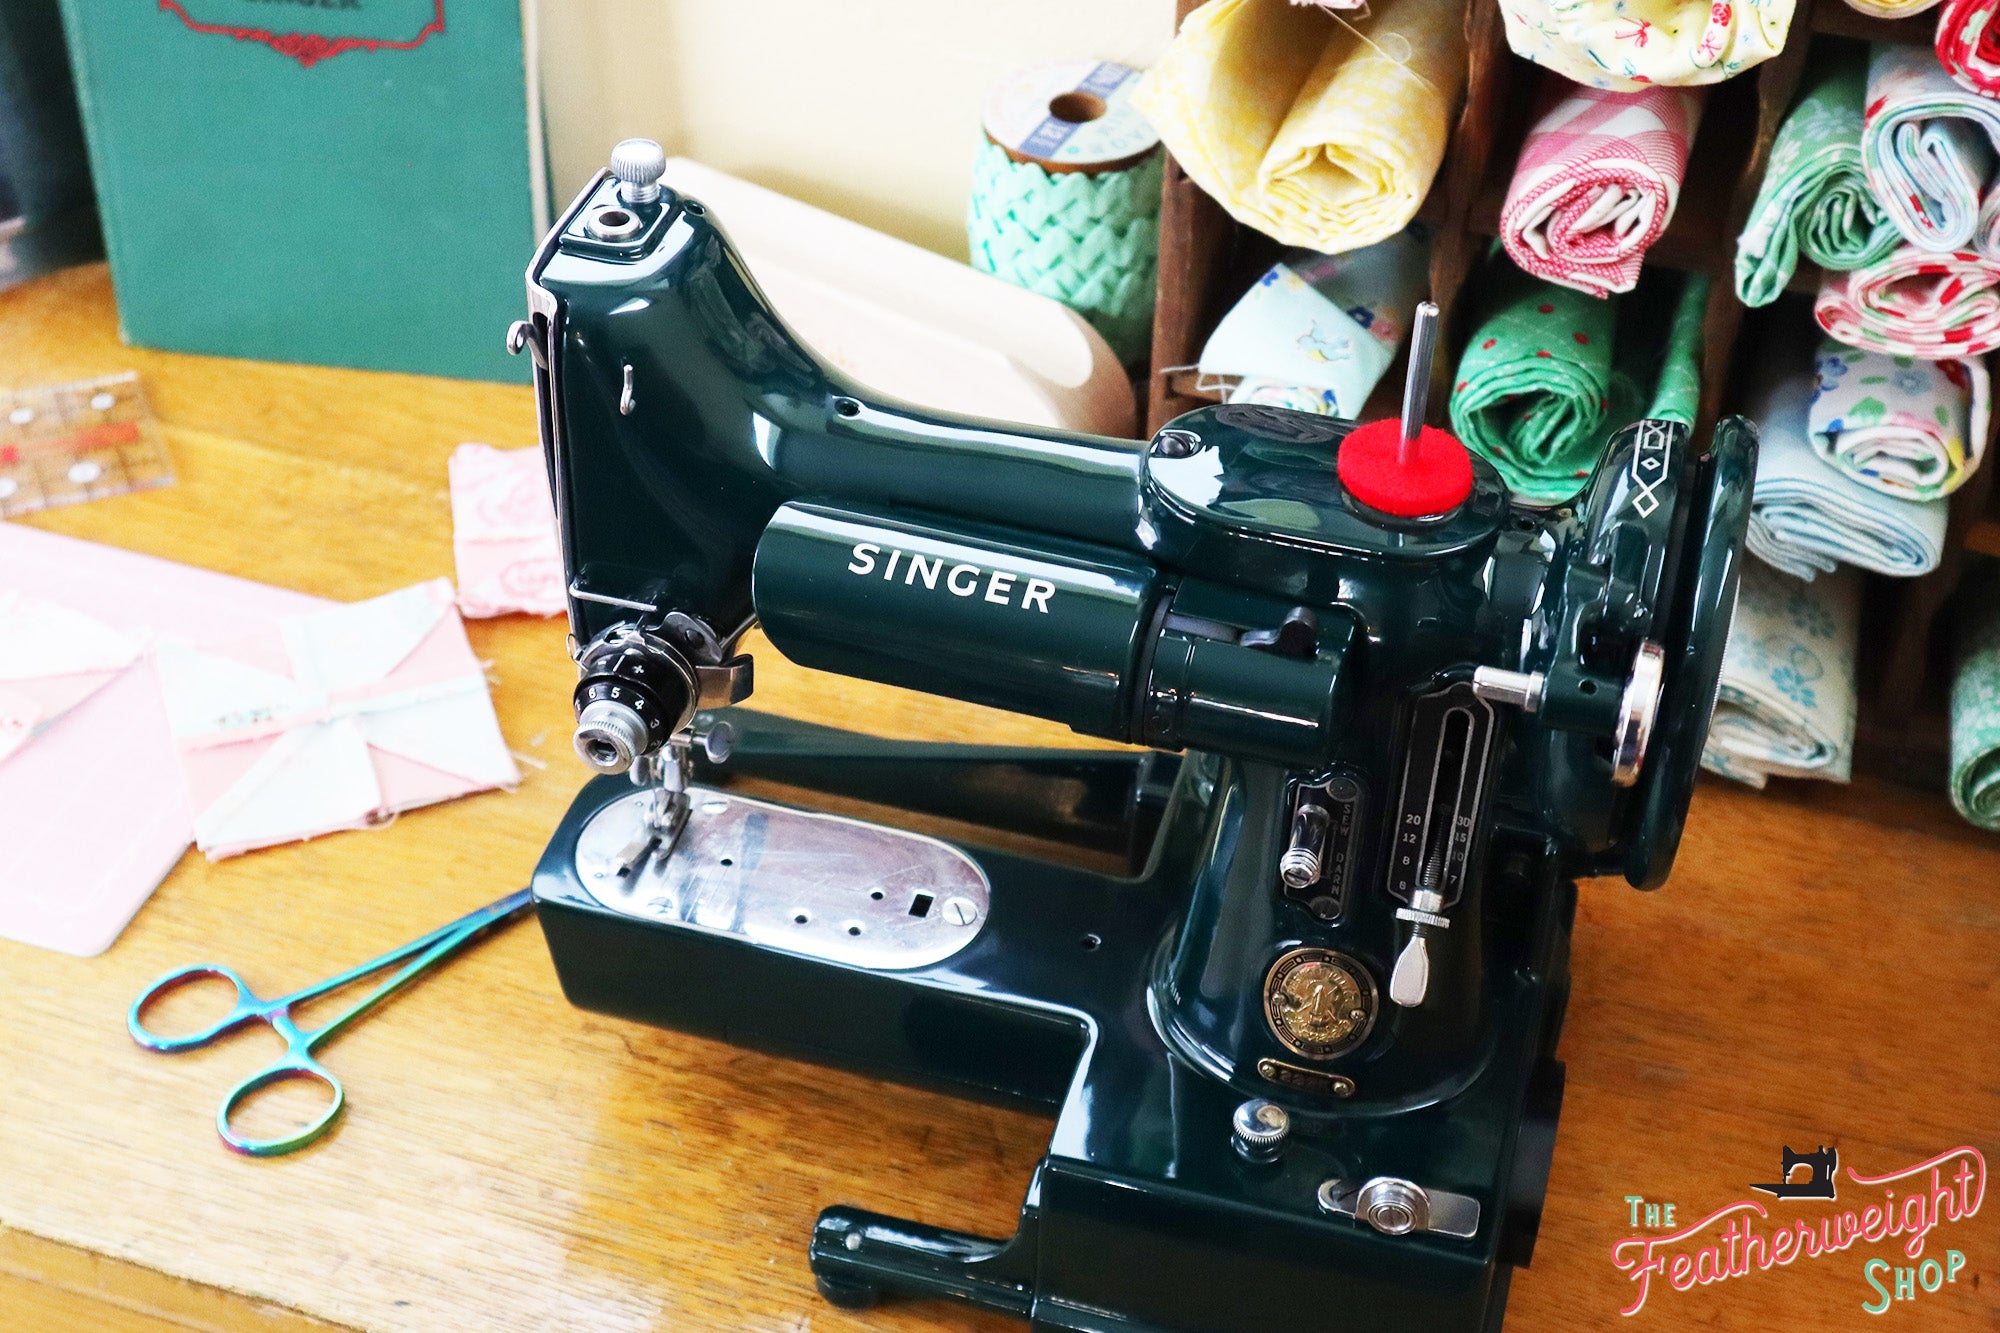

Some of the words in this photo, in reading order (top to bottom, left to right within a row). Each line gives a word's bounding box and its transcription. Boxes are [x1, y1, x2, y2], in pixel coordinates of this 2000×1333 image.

[848, 542, 1056, 614] SINGER
[588, 687, 597, 699] 6
[611, 686, 621, 699] 5
[634, 699, 645, 710] 4
[650, 718, 660, 729] 3
[1339, 803, 1351, 837] SEW
[1405, 814, 1421, 826] 20
[1456, 815, 1471, 827] 30
[1402, 832, 1417, 844] 12
[1454, 831, 1467, 843] 15
[1402, 855, 1410, 866] 8
[1331, 852, 1344, 896] DARN
[1399, 880, 1407, 890] 6
[1449, 875, 1458, 884] 7
